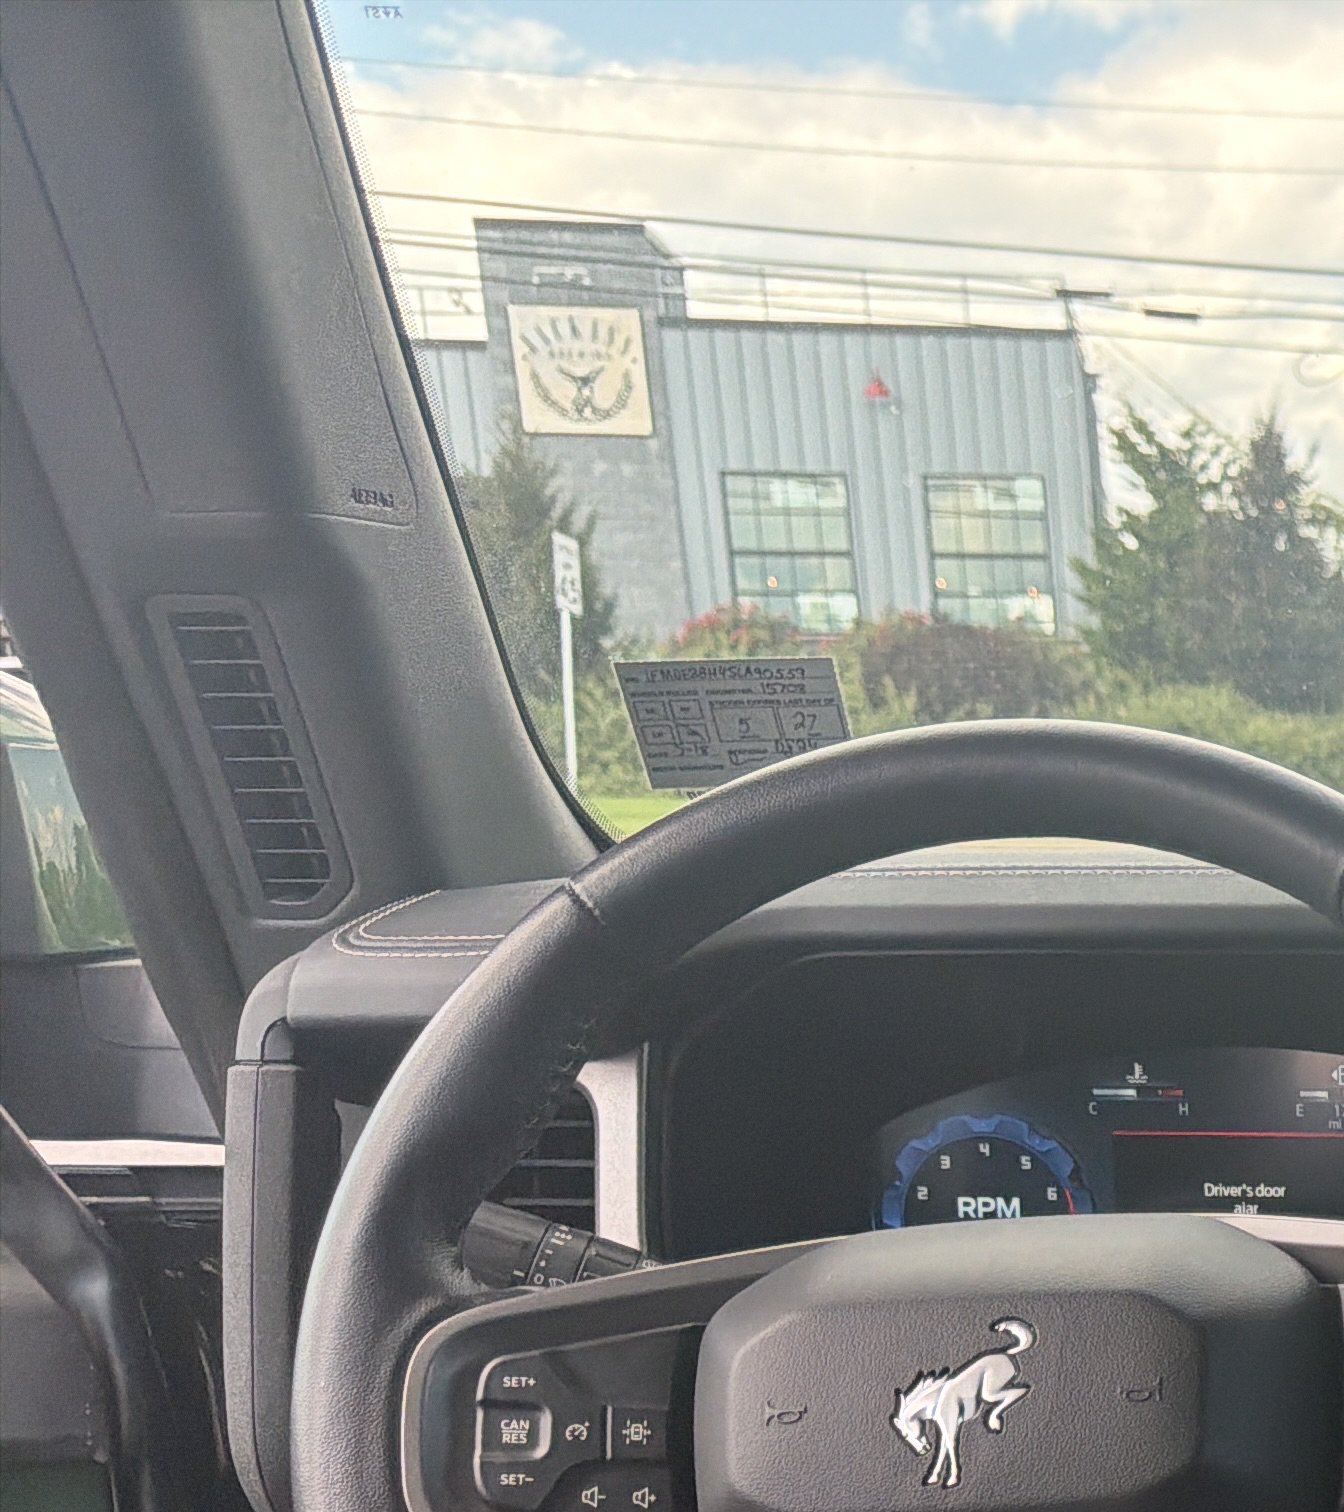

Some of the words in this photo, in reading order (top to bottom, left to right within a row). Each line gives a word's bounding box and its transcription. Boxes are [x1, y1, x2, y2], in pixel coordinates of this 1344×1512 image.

[1088, 1102, 1098, 1116] C
[1179, 1103, 1189, 1116] H
[1296, 1104, 1304, 1117] E
[1328, 1119, 1341, 1129] mi
[979, 1142, 990, 1156] 4
[940, 1154, 950, 1169] 3
[1020, 1155, 1032, 1170] 5
[917, 1186, 929, 1200] 2
[1047, 1187, 1058, 1201] 6
[1204, 1183, 1253, 1198] Driver's
[1255, 1182, 1286, 1198] door
[957, 1197, 1021, 1219] RPM
[503, 1376, 536, 1388] SET+
[500, 1419, 530, 1431] CAN
[502, 1433, 528, 1445] RES
